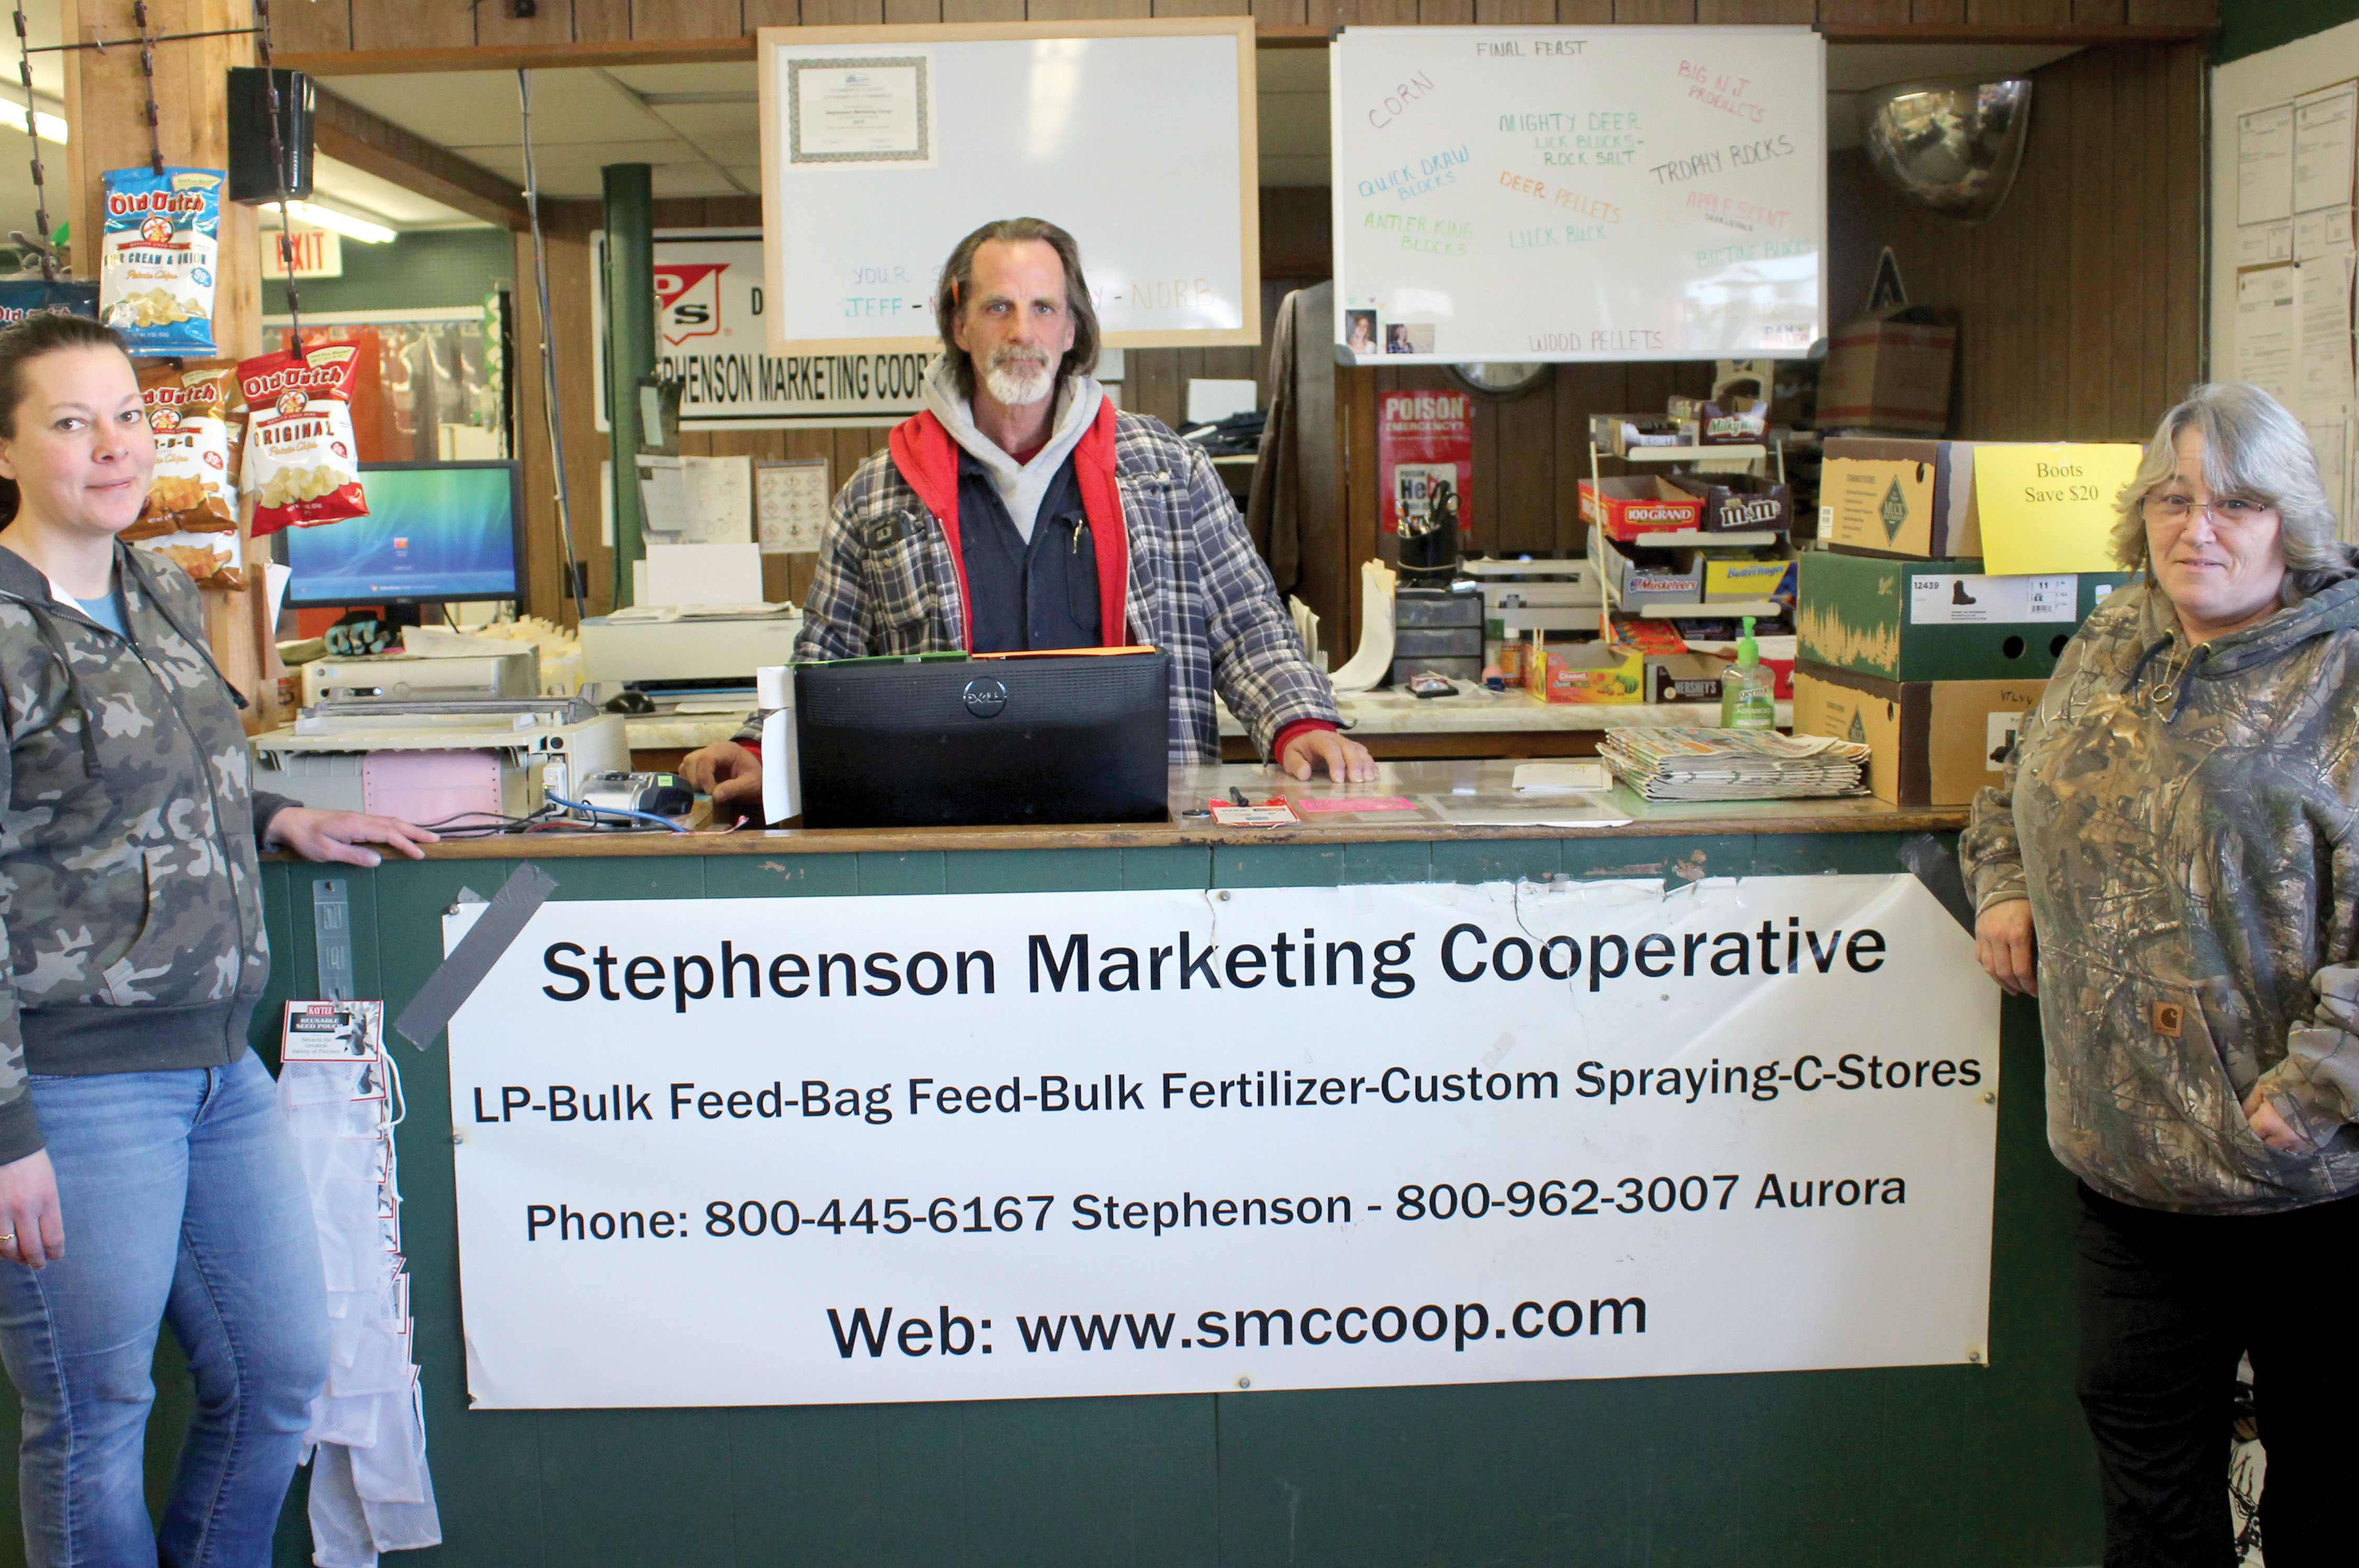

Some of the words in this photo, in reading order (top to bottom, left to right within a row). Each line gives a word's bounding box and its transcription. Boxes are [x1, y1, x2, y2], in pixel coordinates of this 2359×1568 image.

[1477, 41, 1525, 56] FINAL
[1536, 40, 1587, 56] FEAST
[1678, 60, 1707, 84] BIG
[1733, 78, 1750, 96] J
[1369, 71, 1434, 128] CORN
[1689, 85, 1765, 123] PRODUCTS
[1500, 113, 1575, 131] MIGHTY
[1589, 112, 1642, 131] DEER
[1536, 134, 1567, 150] LICK
[1545, 152, 1588, 165] ROCK
[1597, 150, 1634, 164] SALT
[1649, 151, 1722, 184] TROPHY
[1729, 134, 1794, 167] ROCKS
[1359, 166, 1415, 197] QUICK
[1421, 144, 1469, 175] DRAW
[1399, 171, 1457, 200] BLOCKS
[109, 191, 150, 216] Old
[151, 190, 206, 214] Dutch
[1500, 171, 1545, 199] DEER
[1556, 188, 1620, 224] PELLETS
[1686, 190, 1732, 212] APPLE
[1736, 201, 1791, 228] SCENT
[1365, 212, 1428, 233] ANTLER
[1434, 219, 1472, 240] KING
[1566, 224, 1606, 243] BUCK
[275, 232, 324, 272] EXIT
[1402, 236, 1465, 256] BLOCKS
[129, 252, 162, 265] CREAM
[167, 255, 173, 264] &
[853, 266, 911, 284] YOUR
[1133, 278, 1214, 310] NORB
[845, 297, 902, 317] JEFF
[1530, 333, 1581, 351] WOOD
[1592, 329, 1664, 349] PELLETS
[244, 372, 283, 397] Old
[283, 365, 344, 388] Dutch
[760, 354, 868, 401] MARKETING
[157, 383, 217, 405] Dutch
[1386, 396, 1464, 421] POISON
[1708, 417, 1741, 437] Milky
[2037, 463, 2083, 477] Boots
[2025, 487, 2063, 503] Save
[2069, 485, 2098, 502] $20
[1628, 508, 1647, 519] 100
[1648, 508, 1691, 519] GRAND
[1640, 580, 1698, 591] Musketeers
[968, 692, 1002, 703] DELL
[1675, 680, 1717, 695] HERSHEY'S
[543, 941, 994, 1013] Stephenson
[1029, 927, 1415, 998] Marketing
[1441, 917, 1886, 992] Cooperative
[309, 1006, 333, 1015] KAYTEE
[475, 1085, 652, 1122] LP-Bulk
[671, 1081, 891, 1124] Feed-Bag
[910, 1075, 1144, 1114] Feed-Bulk
[1164, 1067, 1557, 1108] Fertilizer-Custom
[1576, 1054, 1981, 1104] Spraying-C-Stores
[528, 1205, 687, 1241] Phone:
[706, 1196, 1054, 1236] 800-445-6167
[1073, 1192, 1350, 1236] Stephenson
[1397, 1175, 1739, 1220] 800-962-3007
[1755, 1174, 1905, 1208] Aurora
[827, 1306, 991, 1360] Web:
[1017, 1296, 1646, 1354] www.smccoop.com
